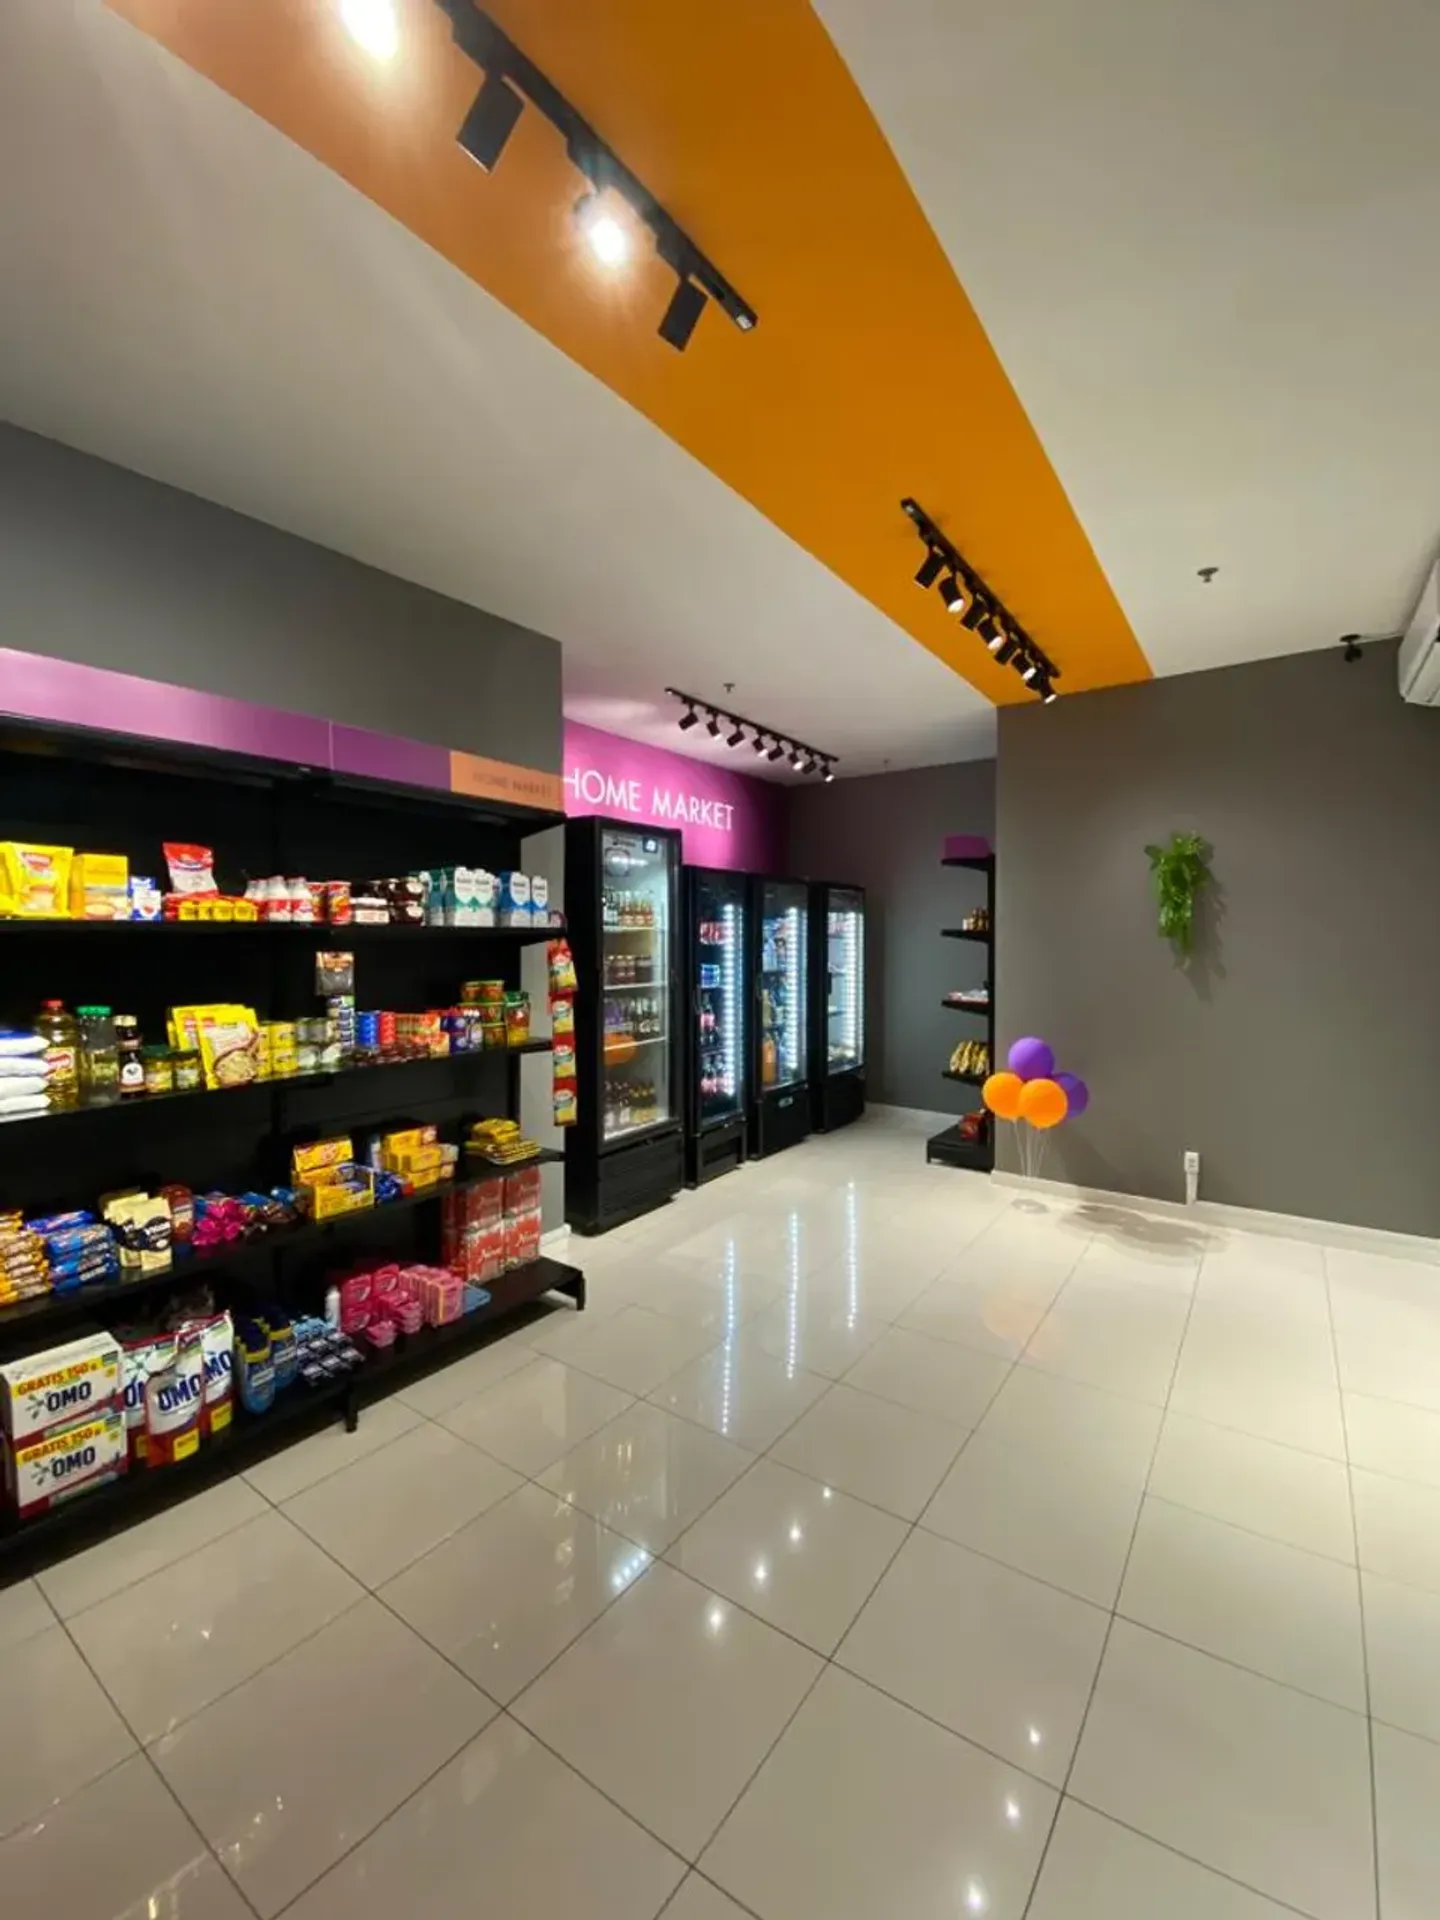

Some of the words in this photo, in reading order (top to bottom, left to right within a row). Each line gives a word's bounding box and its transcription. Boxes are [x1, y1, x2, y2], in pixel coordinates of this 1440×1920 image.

[652, 787, 734, 831] MARKET
[46, 1380, 92, 1412] OMO
[157, 1374, 201, 1411] OMO
[51, 1446, 96, 1477] OMO
